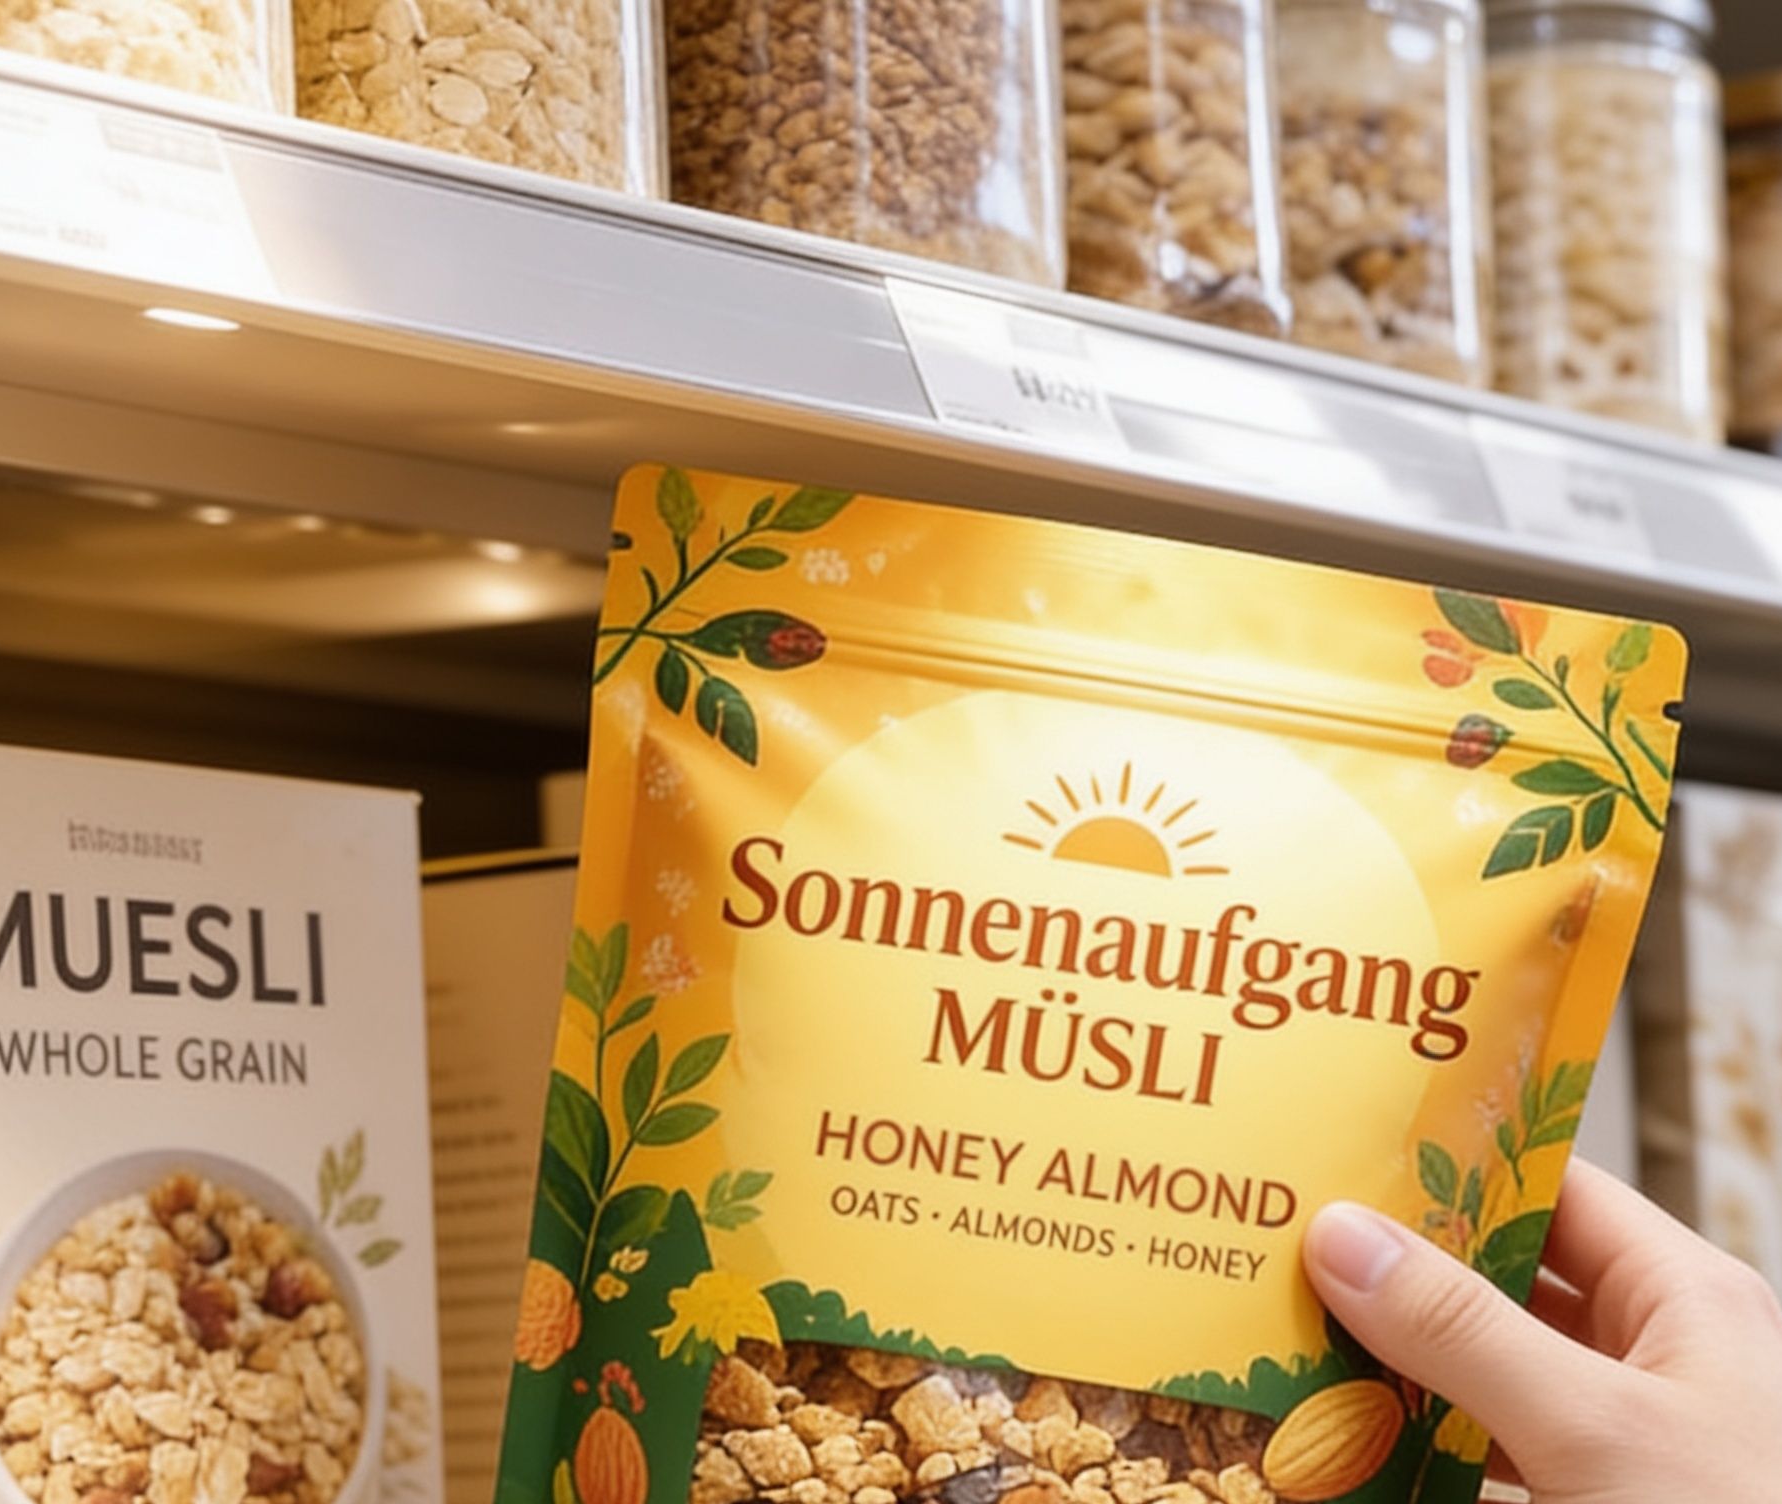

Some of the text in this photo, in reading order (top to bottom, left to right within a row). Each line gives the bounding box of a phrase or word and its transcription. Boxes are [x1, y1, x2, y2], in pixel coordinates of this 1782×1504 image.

[721, 836, 1480, 1062] Sonnenaufgang
[176, 1036, 308, 1086] GRAIN
[922, 987, 1225, 1107] MÜSLI
[815, 1111, 1297, 1230] HONEY ALMOND
[831, 1185, 1267, 1284] OATS ALMONDS HONEY
